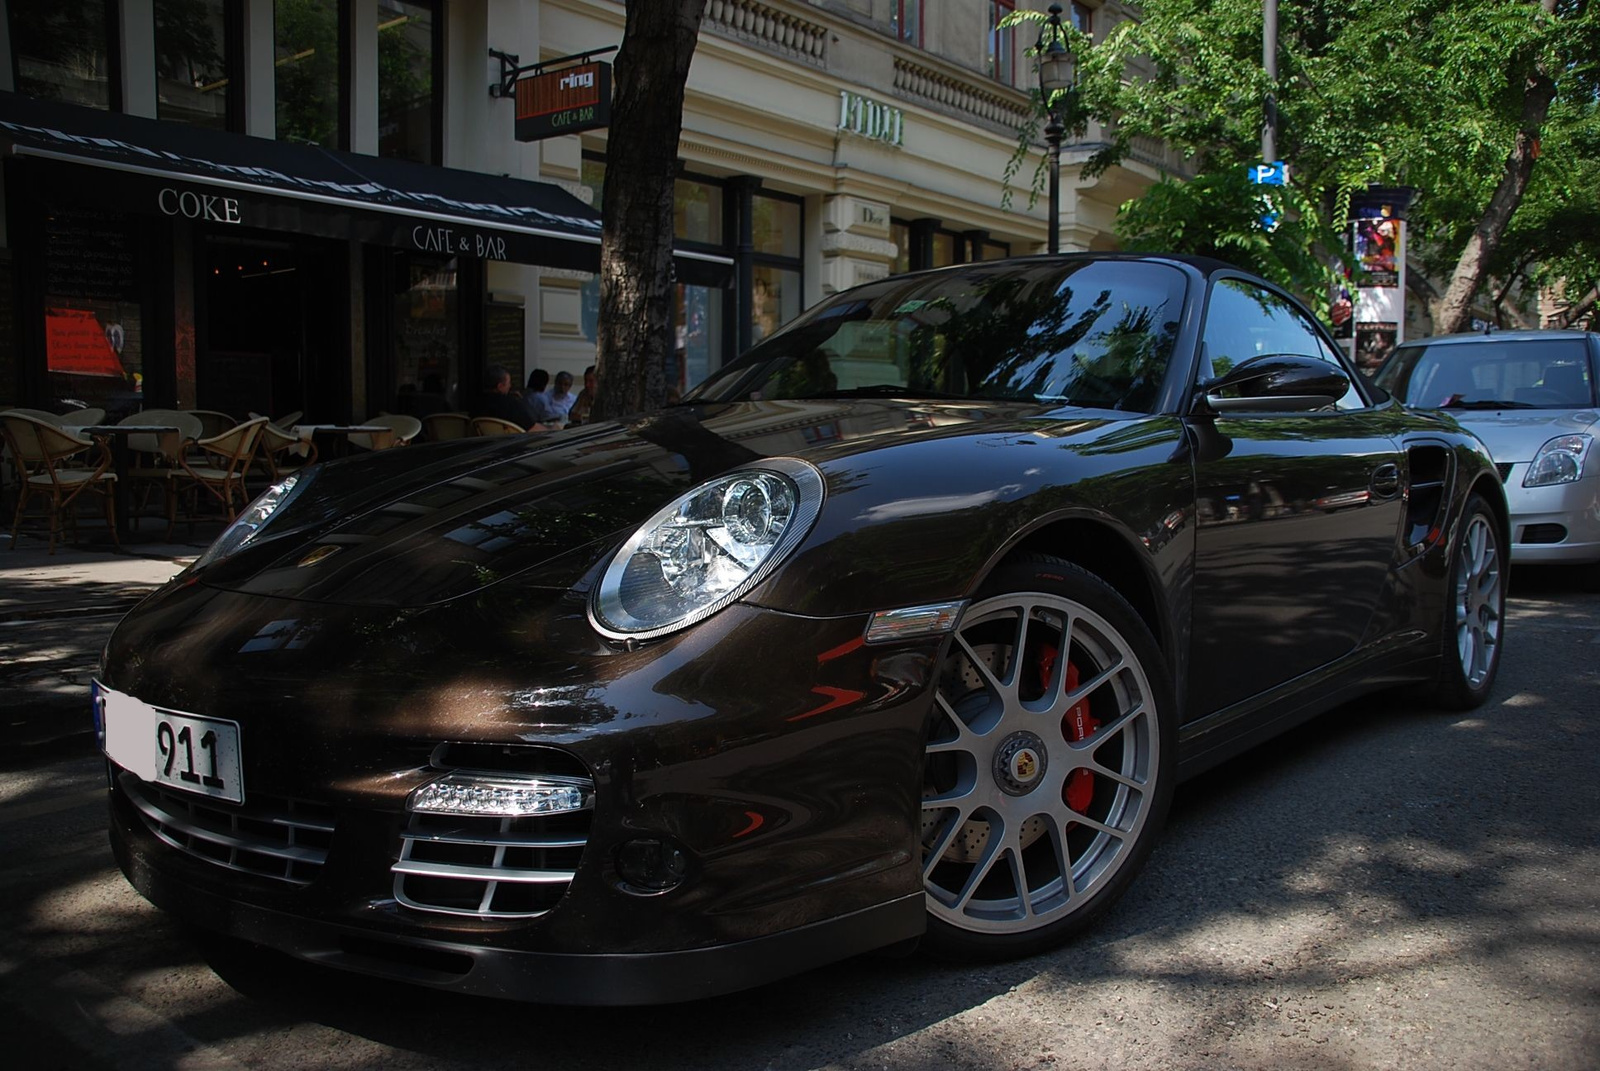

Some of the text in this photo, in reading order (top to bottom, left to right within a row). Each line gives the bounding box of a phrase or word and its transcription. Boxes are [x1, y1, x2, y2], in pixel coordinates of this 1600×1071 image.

[560, 71, 594, 91] ring
[552, 111, 571, 127] CAFE
[579, 107, 594, 122] BAR
[1257, 165, 1275, 184] P
[158, 187, 242, 225] COKE
[412, 224, 507, 261] CAFE & BAR
[158, 720, 225, 789] 911
